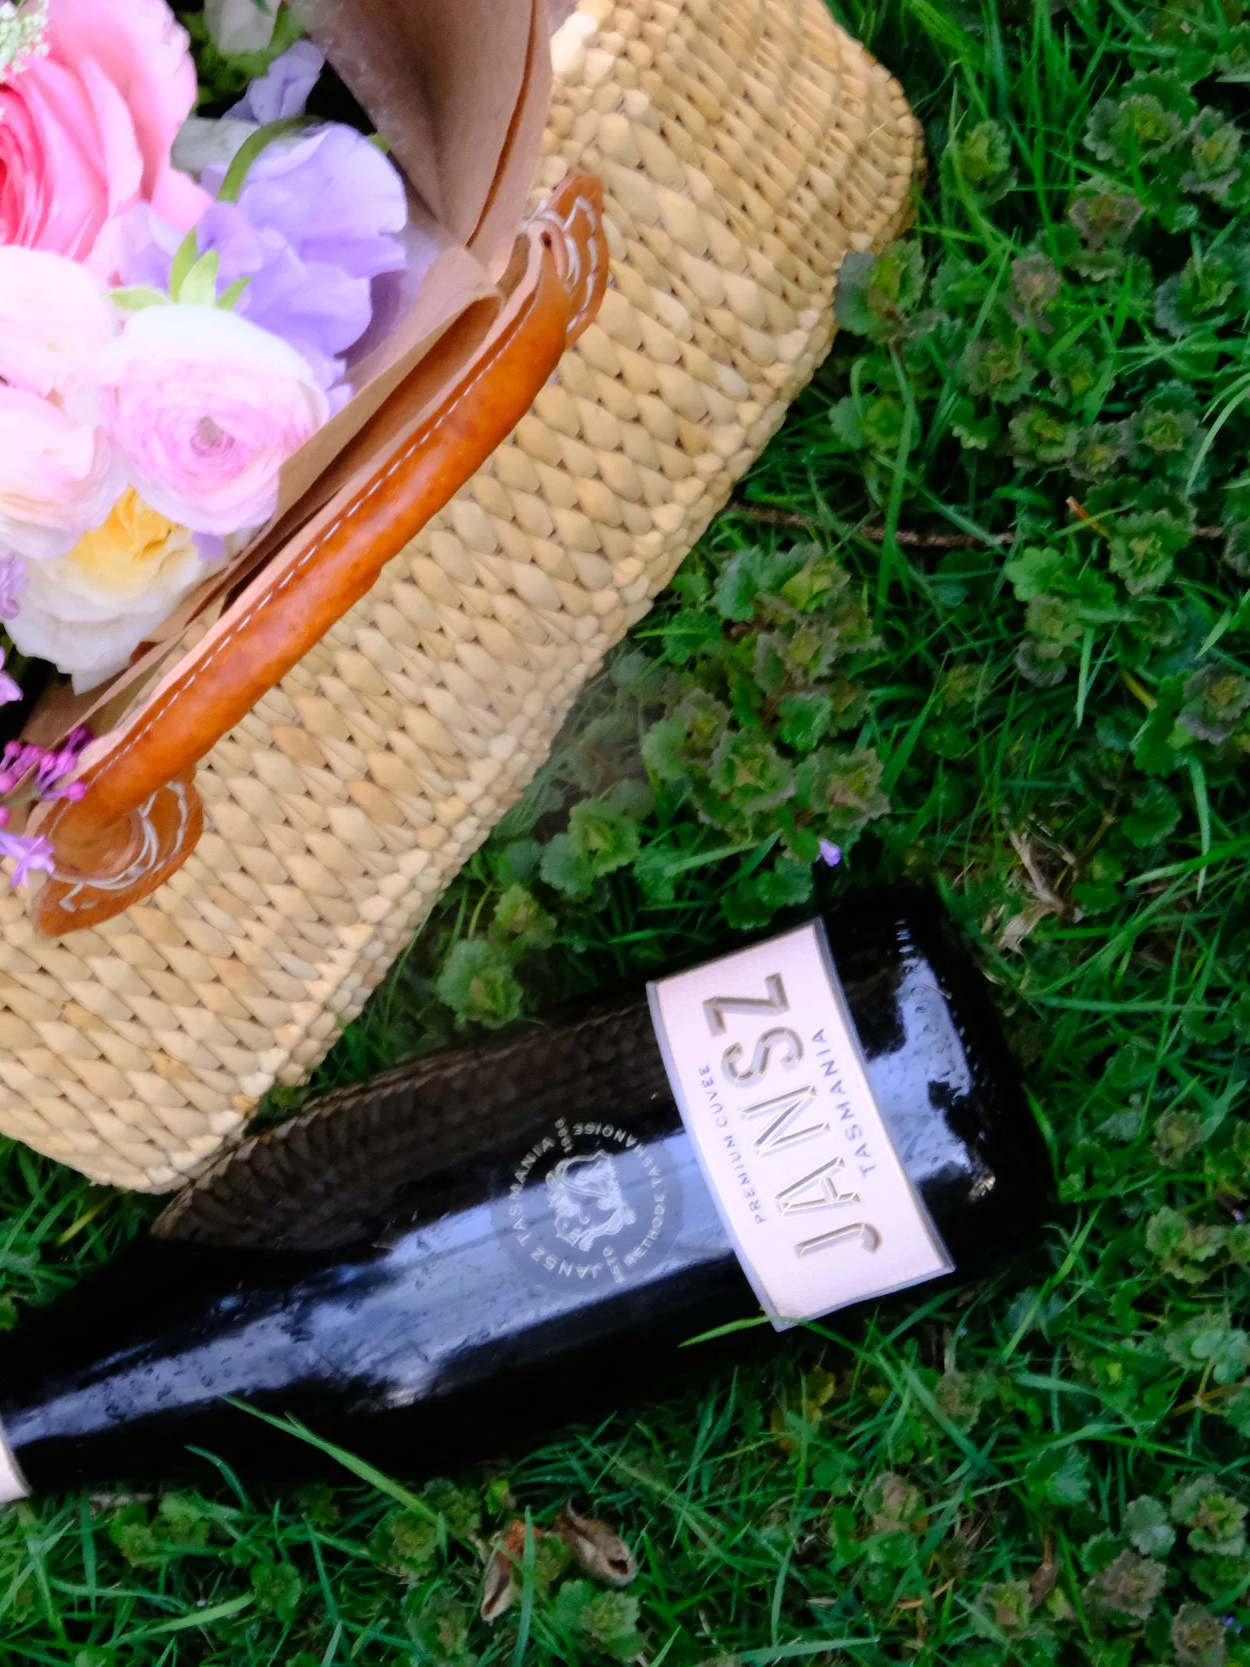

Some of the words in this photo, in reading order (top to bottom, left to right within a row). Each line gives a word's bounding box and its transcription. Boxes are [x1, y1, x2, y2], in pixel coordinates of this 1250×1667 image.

[697, 1063, 729, 1128] CUVÉE
[702, 972, 882, 1259] JANSZ
[811, 1028, 876, 1179] TASMANIA
[509, 1136, 556, 1247] TASMANIA
[572, 1122, 664, 1188] TASMANOISE
[723, 1134, 766, 1225] PREMIUM
[530, 1244, 603, 1279] JANSZ
